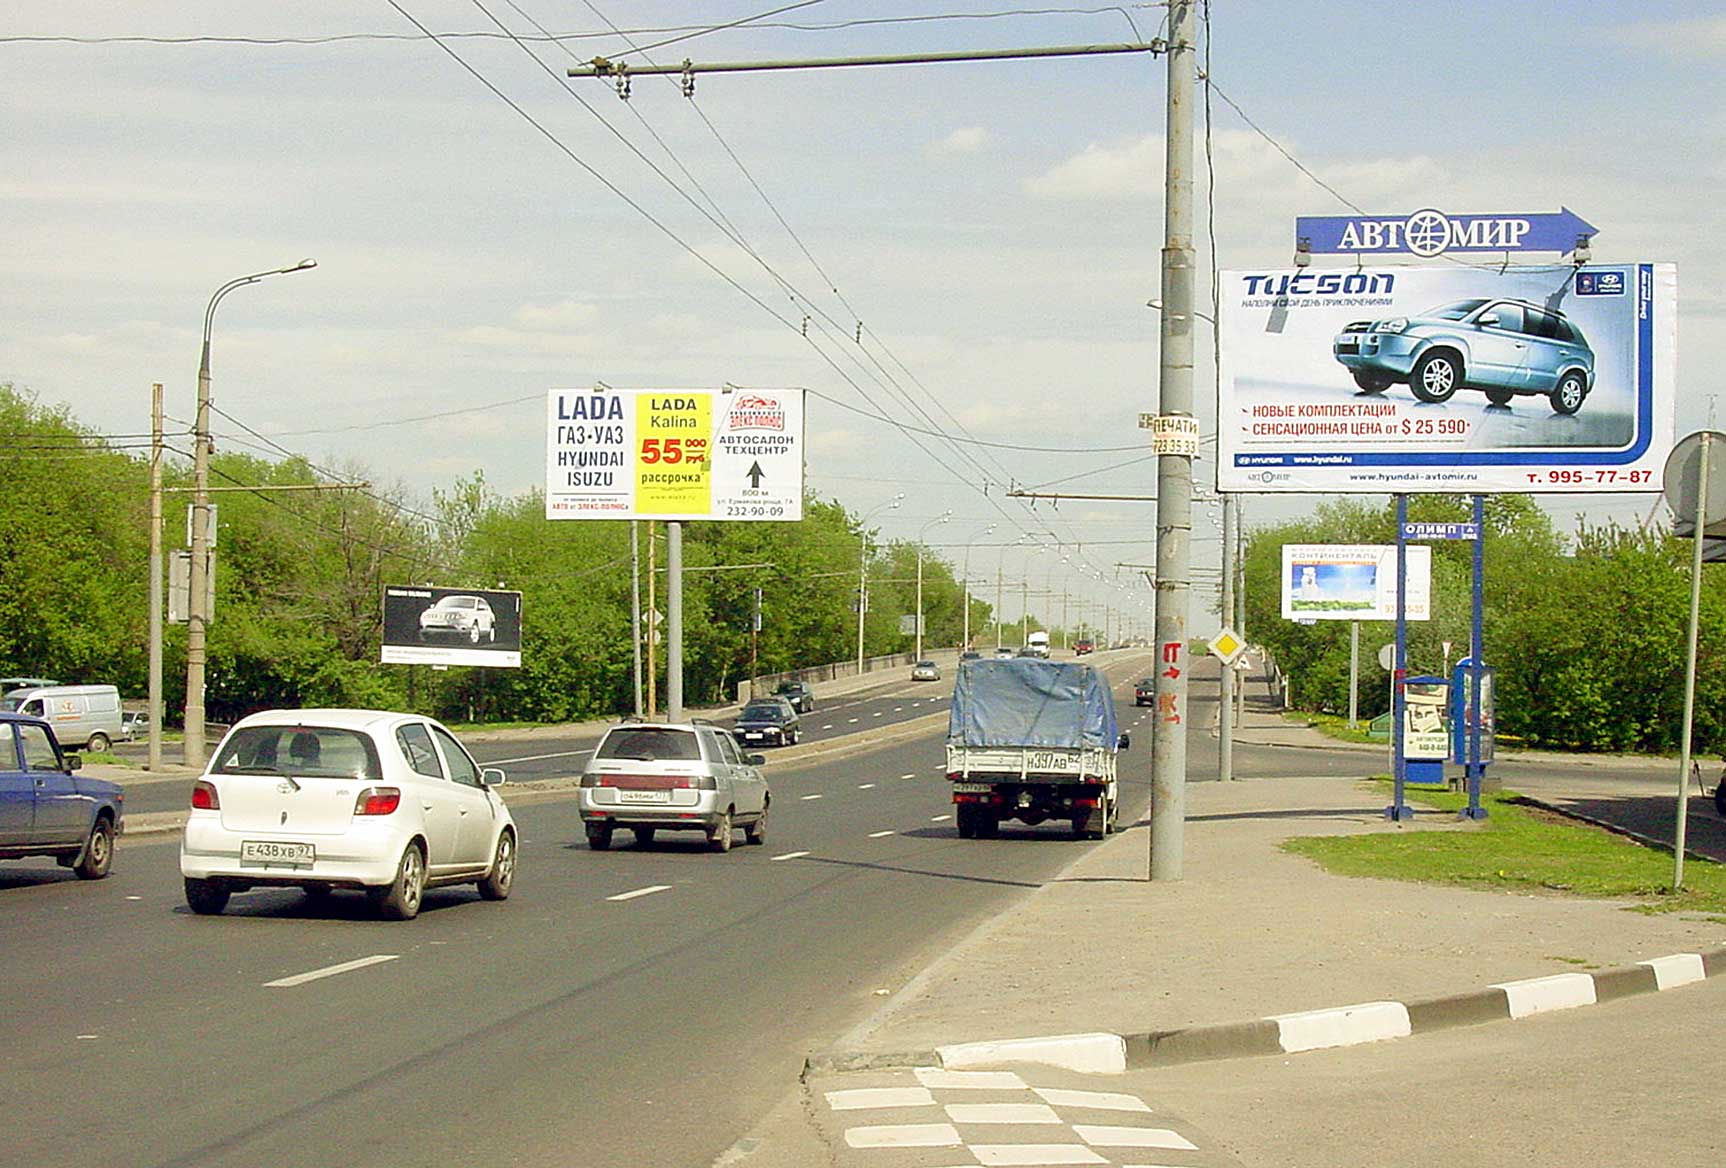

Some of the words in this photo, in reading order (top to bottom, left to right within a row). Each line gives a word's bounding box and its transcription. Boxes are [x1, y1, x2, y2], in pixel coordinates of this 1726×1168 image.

[1242, 273, 1394, 295] TUCSON
[558, 396, 624, 420] LADA
[651, 398, 697, 411] LADA
[1252, 405, 1295, 417] НОВЫЕ
[1298, 404, 1396, 418] КОМПЛЕКТАЦИИ
[651, 415, 697, 428] Kalina
[1153, 419, 1197, 434] ПЕЧАТИ
[1252, 422, 1349, 437] СЕНСАЦИОННАЯ
[1351, 422, 1382, 437] ЦЕНА
[1386, 424, 1398, 435] от
[1401, 418, 1411, 437] $
[1415, 419, 1433, 434] 25
[719, 435, 794, 444] АВТОСАЛОН
[641, 438, 683, 464] 55
[725, 446, 788, 456] ТЕХЦЕНТР
[558, 451, 624, 467] HYUNDAI
[567, 471, 613, 487] ISUZU
[1349, 471, 1478, 483] www.hyundai-avtomir.ru
[1549, 470, 1653, 484] 995-77-87
[727, 506, 784, 516] 232-90-09
[1405, 524, 1457, 534] ОЛИМП
